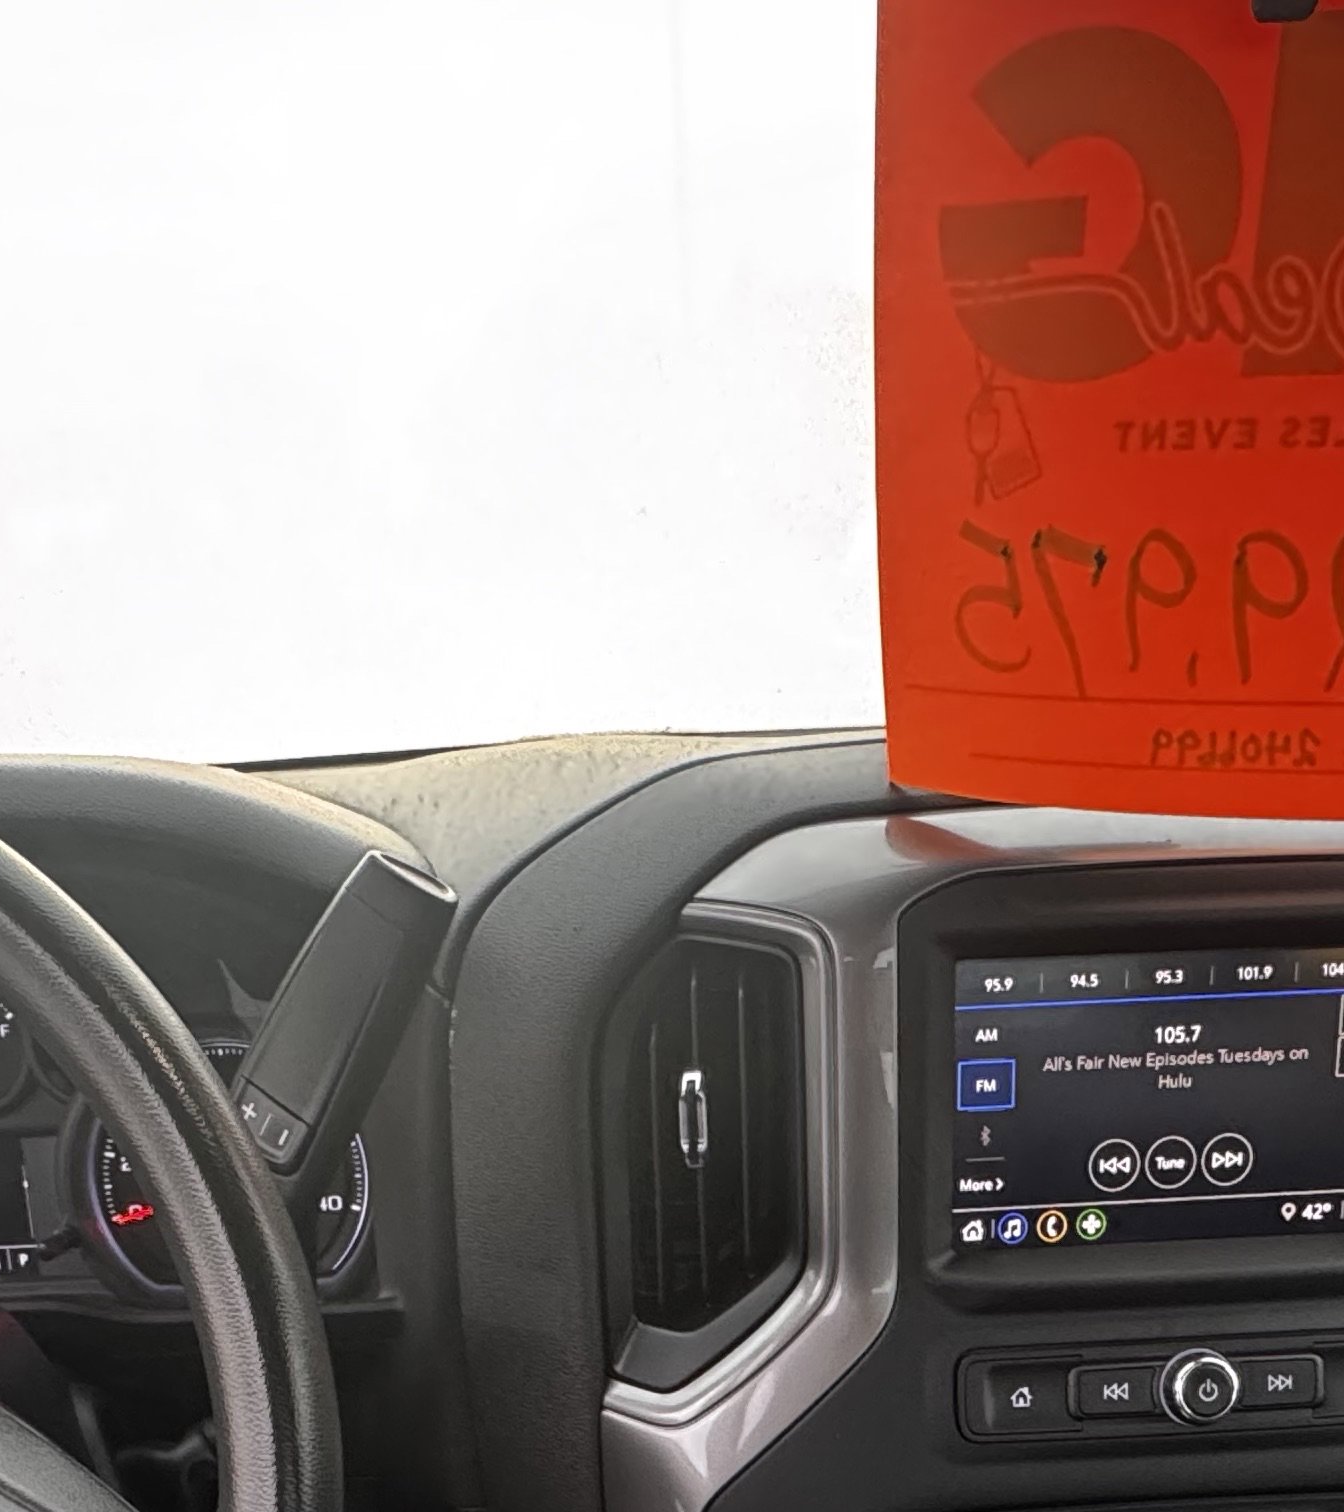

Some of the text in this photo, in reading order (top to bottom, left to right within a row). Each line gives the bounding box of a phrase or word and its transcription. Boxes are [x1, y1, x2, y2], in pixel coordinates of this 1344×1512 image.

[984, 977, 1014, 993] 95.9
[1070, 973, 1099, 988] 94.5
[1155, 969, 1184, 985] 95.3
[1237, 965, 1274, 981] 101.9
[0, 1024, 11, 1038] F
[975, 1028, 999, 1042] AM
[1155, 1024, 1202, 1044] 105.7
[1042, 1048, 1309, 1072] All's Fair New Episodes Tuesdays on
[976, 1078, 997, 1092] FM
[1158, 1073, 1193, 1089] Hulu
[1155, 1156, 1186, 1170] Tune
[959, 1178, 993, 1192] More
[1301, 1202, 1332, 1220] 42°
